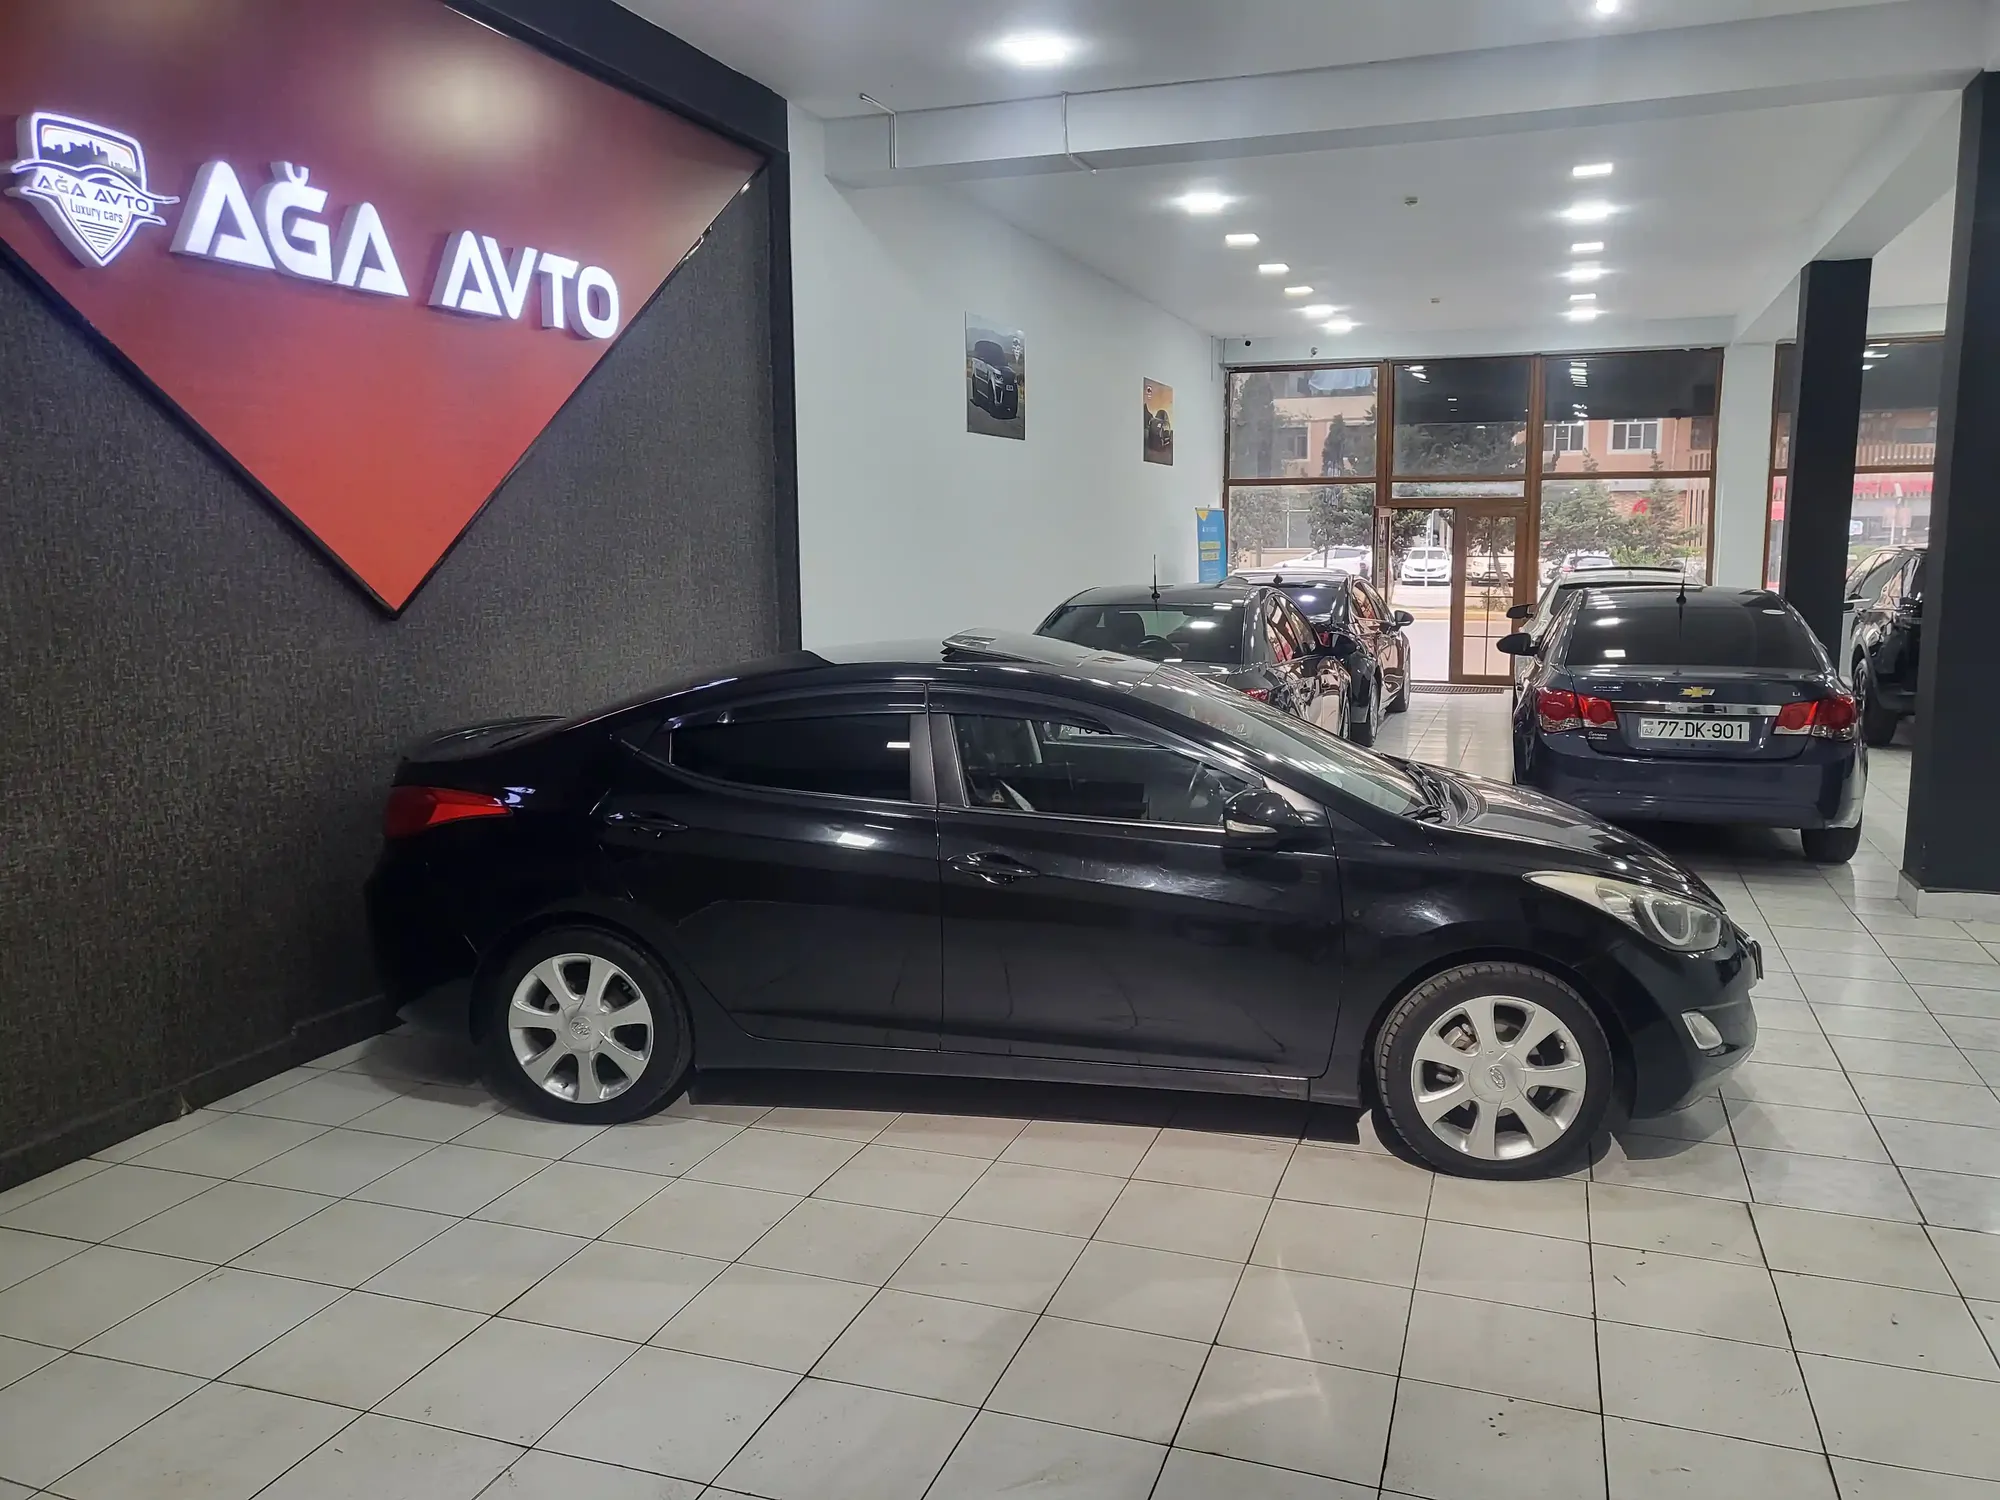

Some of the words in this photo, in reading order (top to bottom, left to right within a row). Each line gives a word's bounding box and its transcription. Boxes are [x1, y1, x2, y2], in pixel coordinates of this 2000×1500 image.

[37, 174, 87, 199] AĞA
[94, 188, 149, 212] AVTO
[69, 197, 101, 221] Luxury
[103, 209, 123, 223] cars
[174, 159, 409, 297] AĞA
[433, 229, 620, 340] AVTO
[1657, 720, 1743, 740] 77-DK-901
